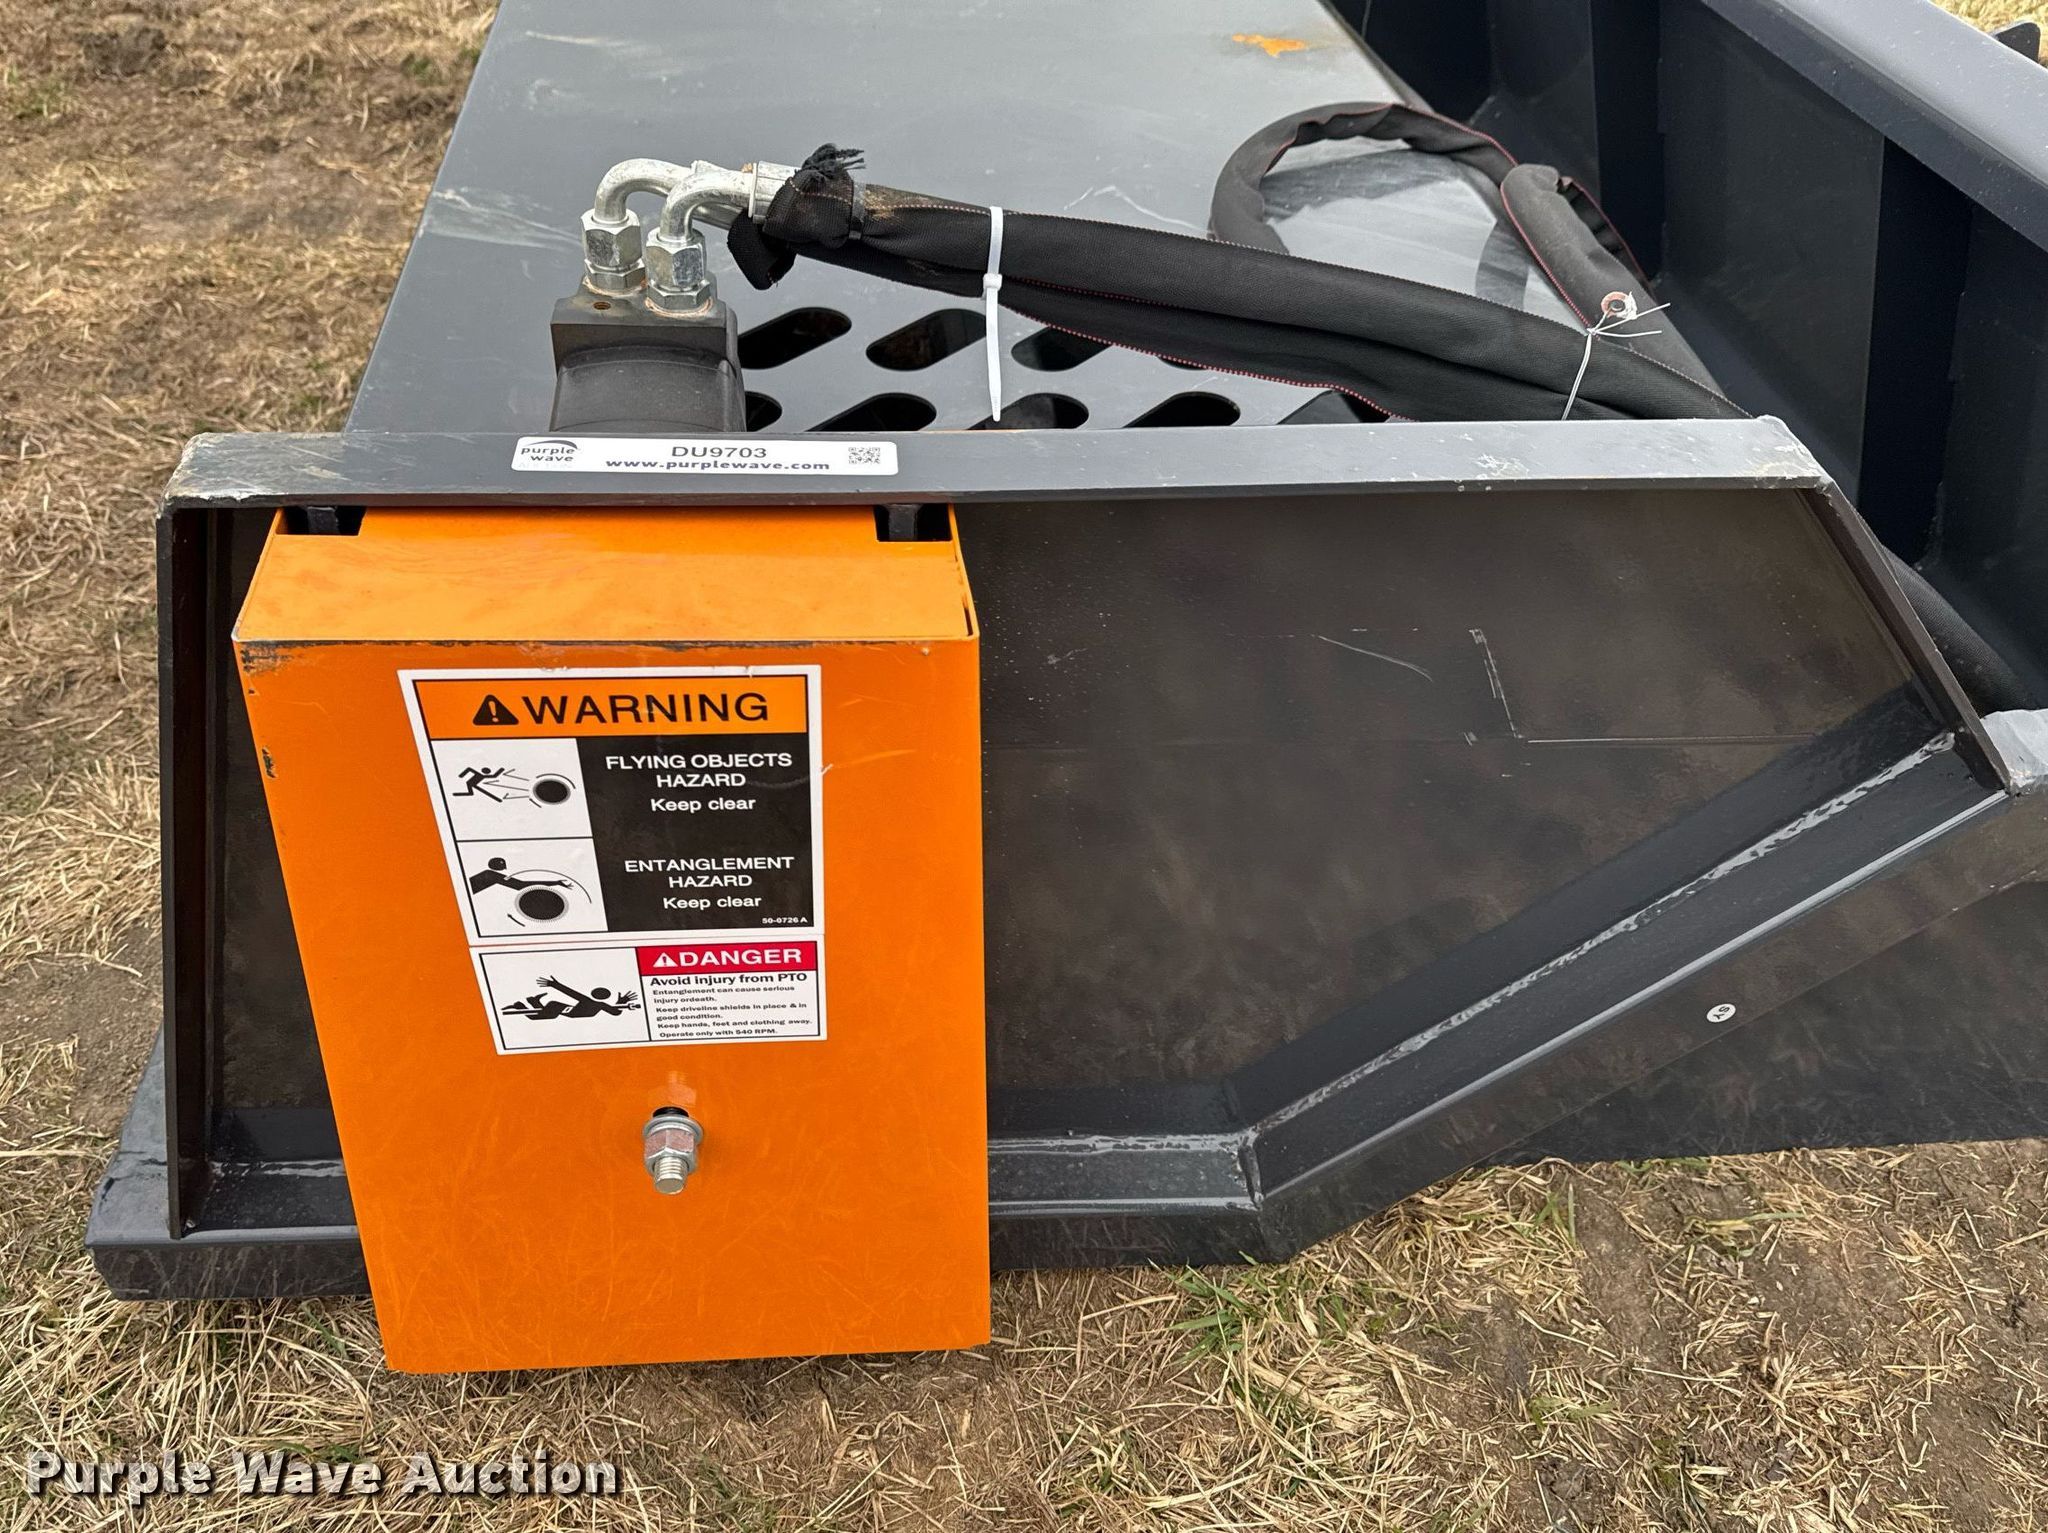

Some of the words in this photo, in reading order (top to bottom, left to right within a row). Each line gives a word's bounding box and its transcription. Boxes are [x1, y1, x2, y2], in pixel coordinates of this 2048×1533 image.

[521, 447, 575, 455] purple
[672, 446, 767, 458] DU9703
[606, 460, 830, 470] www.purplewave.com
[522, 692, 768, 724] WARNING
[605, 754, 687, 770] FLYING
[691, 752, 793, 768] OBJECTS
[656, 772, 746, 788] HAZARD
[650, 798, 702, 813] Keep
[708, 797, 756, 811] clear
[624, 856, 795, 873] ENTANGLEMENT
[668, 873, 753, 888] HAZARD
[663, 896, 712, 911] Keep
[716, 895, 762, 908] clear
[679, 949, 802, 967] DANGER
[649, 975, 692, 986] Avoid
[694, 974, 737, 986] injury
[739, 973, 774, 984] from
[777, 972, 808, 982] PTO
